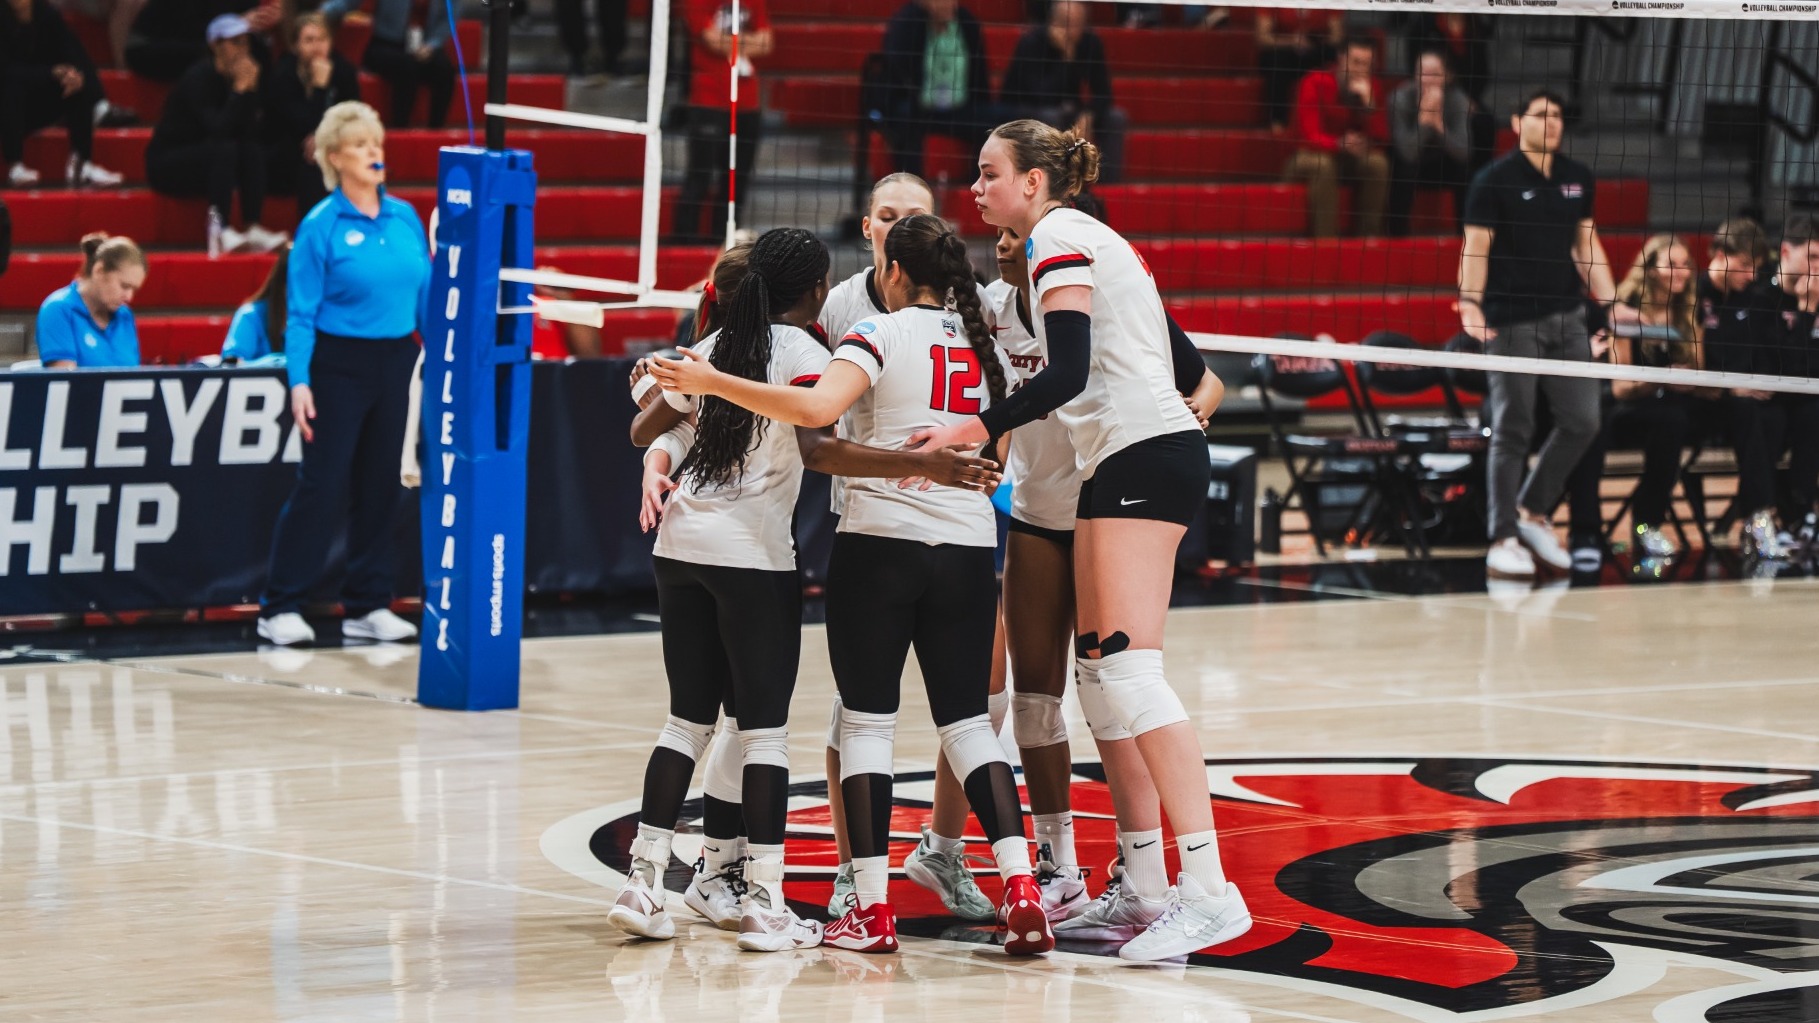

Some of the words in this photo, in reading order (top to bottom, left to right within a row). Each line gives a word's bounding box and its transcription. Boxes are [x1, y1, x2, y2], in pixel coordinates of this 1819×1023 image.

[1648, 2, 1685, 10] CHAMPIONSHIP
[1749, 4, 1778, 12] VOLLEYBALL
[929, 344, 983, 415] 12
[436, 245, 462, 651] VOLLEYBALL
[0, 482, 180, 577] HIP
